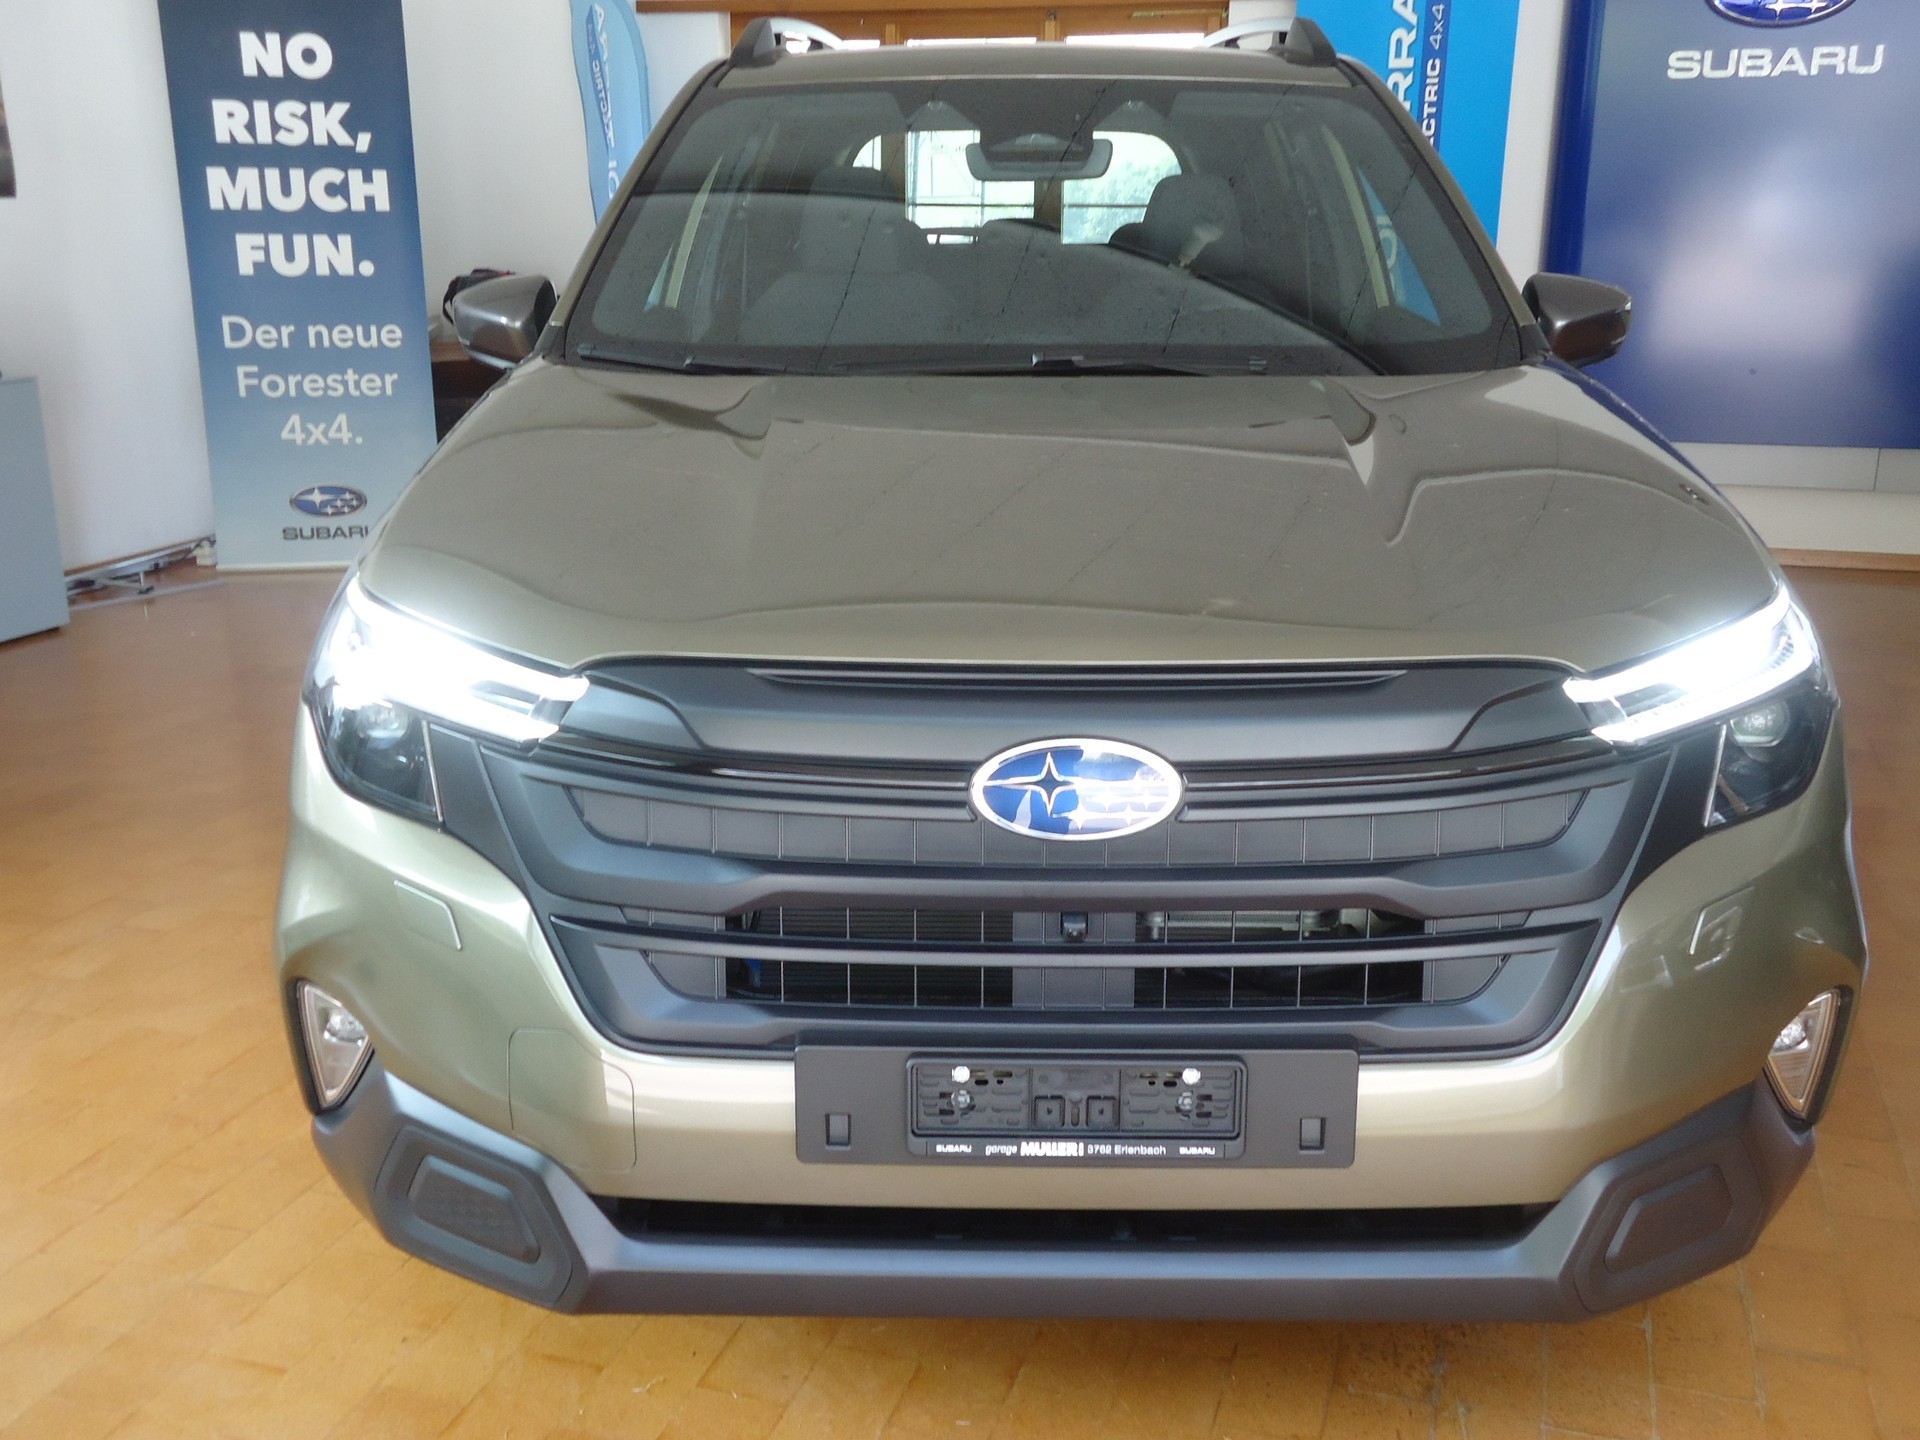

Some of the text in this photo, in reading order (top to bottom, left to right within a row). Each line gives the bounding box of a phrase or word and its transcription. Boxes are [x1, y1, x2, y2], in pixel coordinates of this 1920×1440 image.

[1429, 3, 1445, 51] 4x4
[239, 30, 333, 80] NO
[1667, 44, 1885, 79] SUBARU
[211, 98, 372, 153] RISK,
[205, 166, 390, 213] MUCH
[235, 233, 375, 278] FUN.
[221, 314, 403, 349] Der neue
[236, 365, 398, 398] Forester
[280, 413, 363, 446] 4x4.
[936, 1144, 972, 1153] SUBARU
[985, 1144, 1018, 1156] garage
[1114, 1144, 1167, 1156] Erlenbach
[1179, 1147, 1216, 1155] SUBARU
